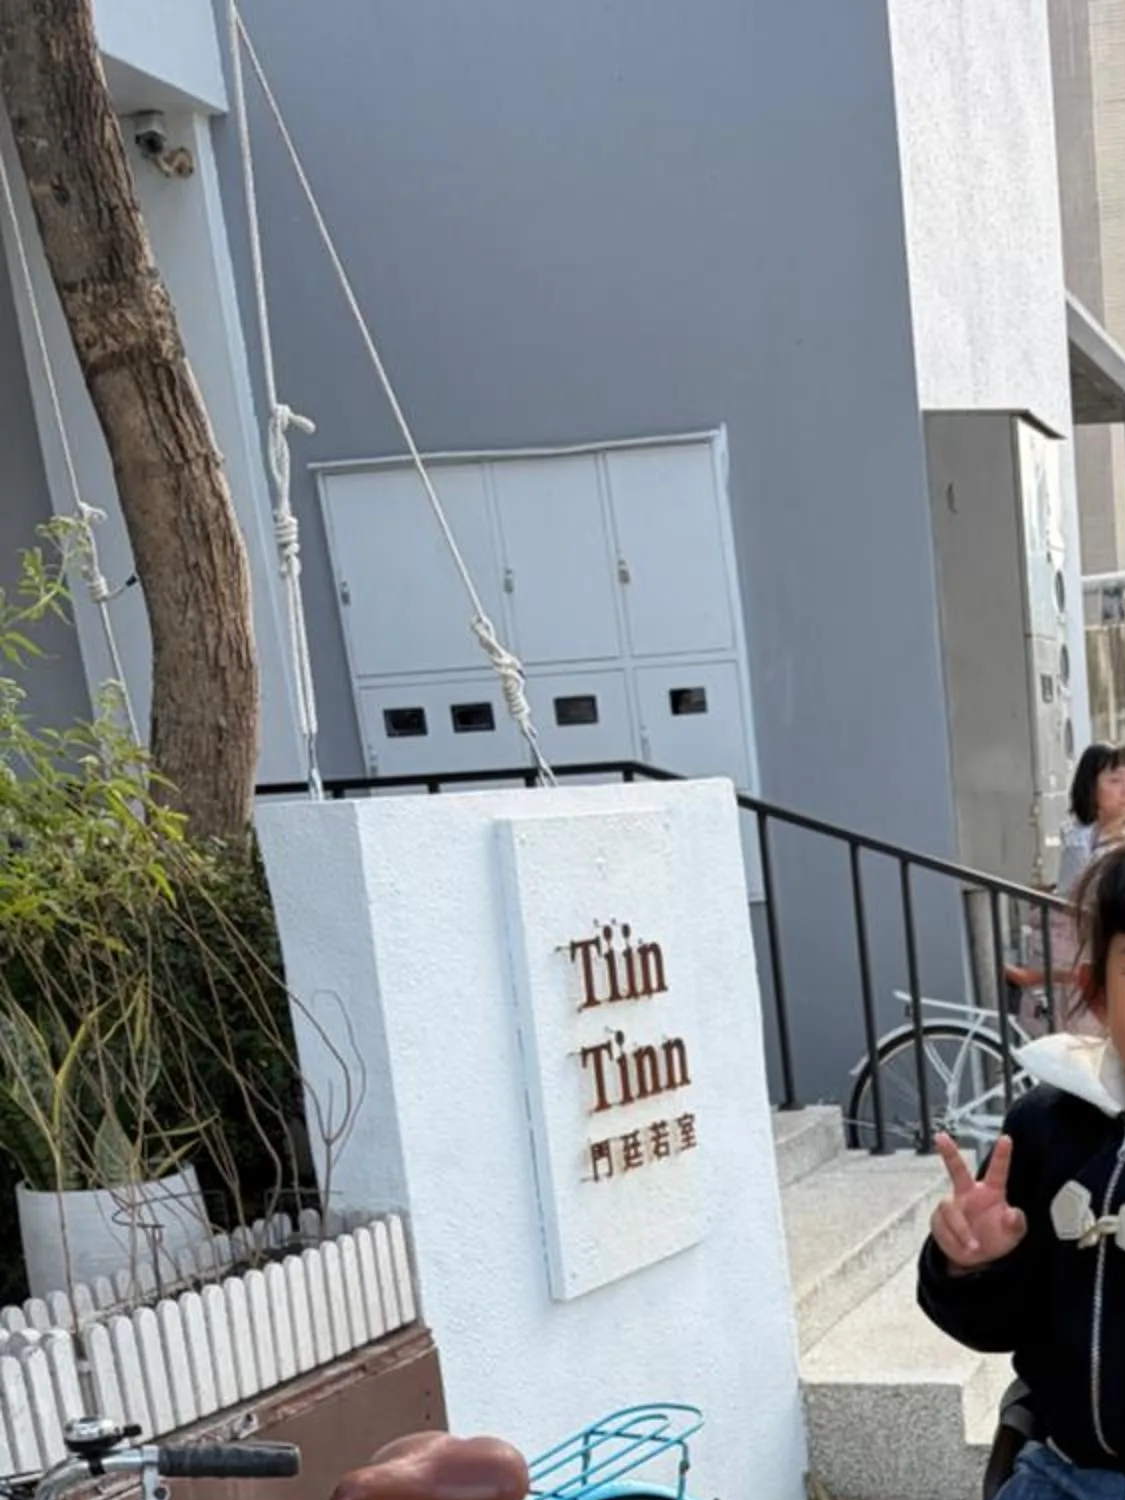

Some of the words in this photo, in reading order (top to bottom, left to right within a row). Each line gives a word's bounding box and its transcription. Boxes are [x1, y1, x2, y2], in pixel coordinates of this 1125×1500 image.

[569, 923, 669, 1010] Tiin
[581, 1030, 692, 1114] Tinn
[590, 1113, 697, 1182] 門廷若室
